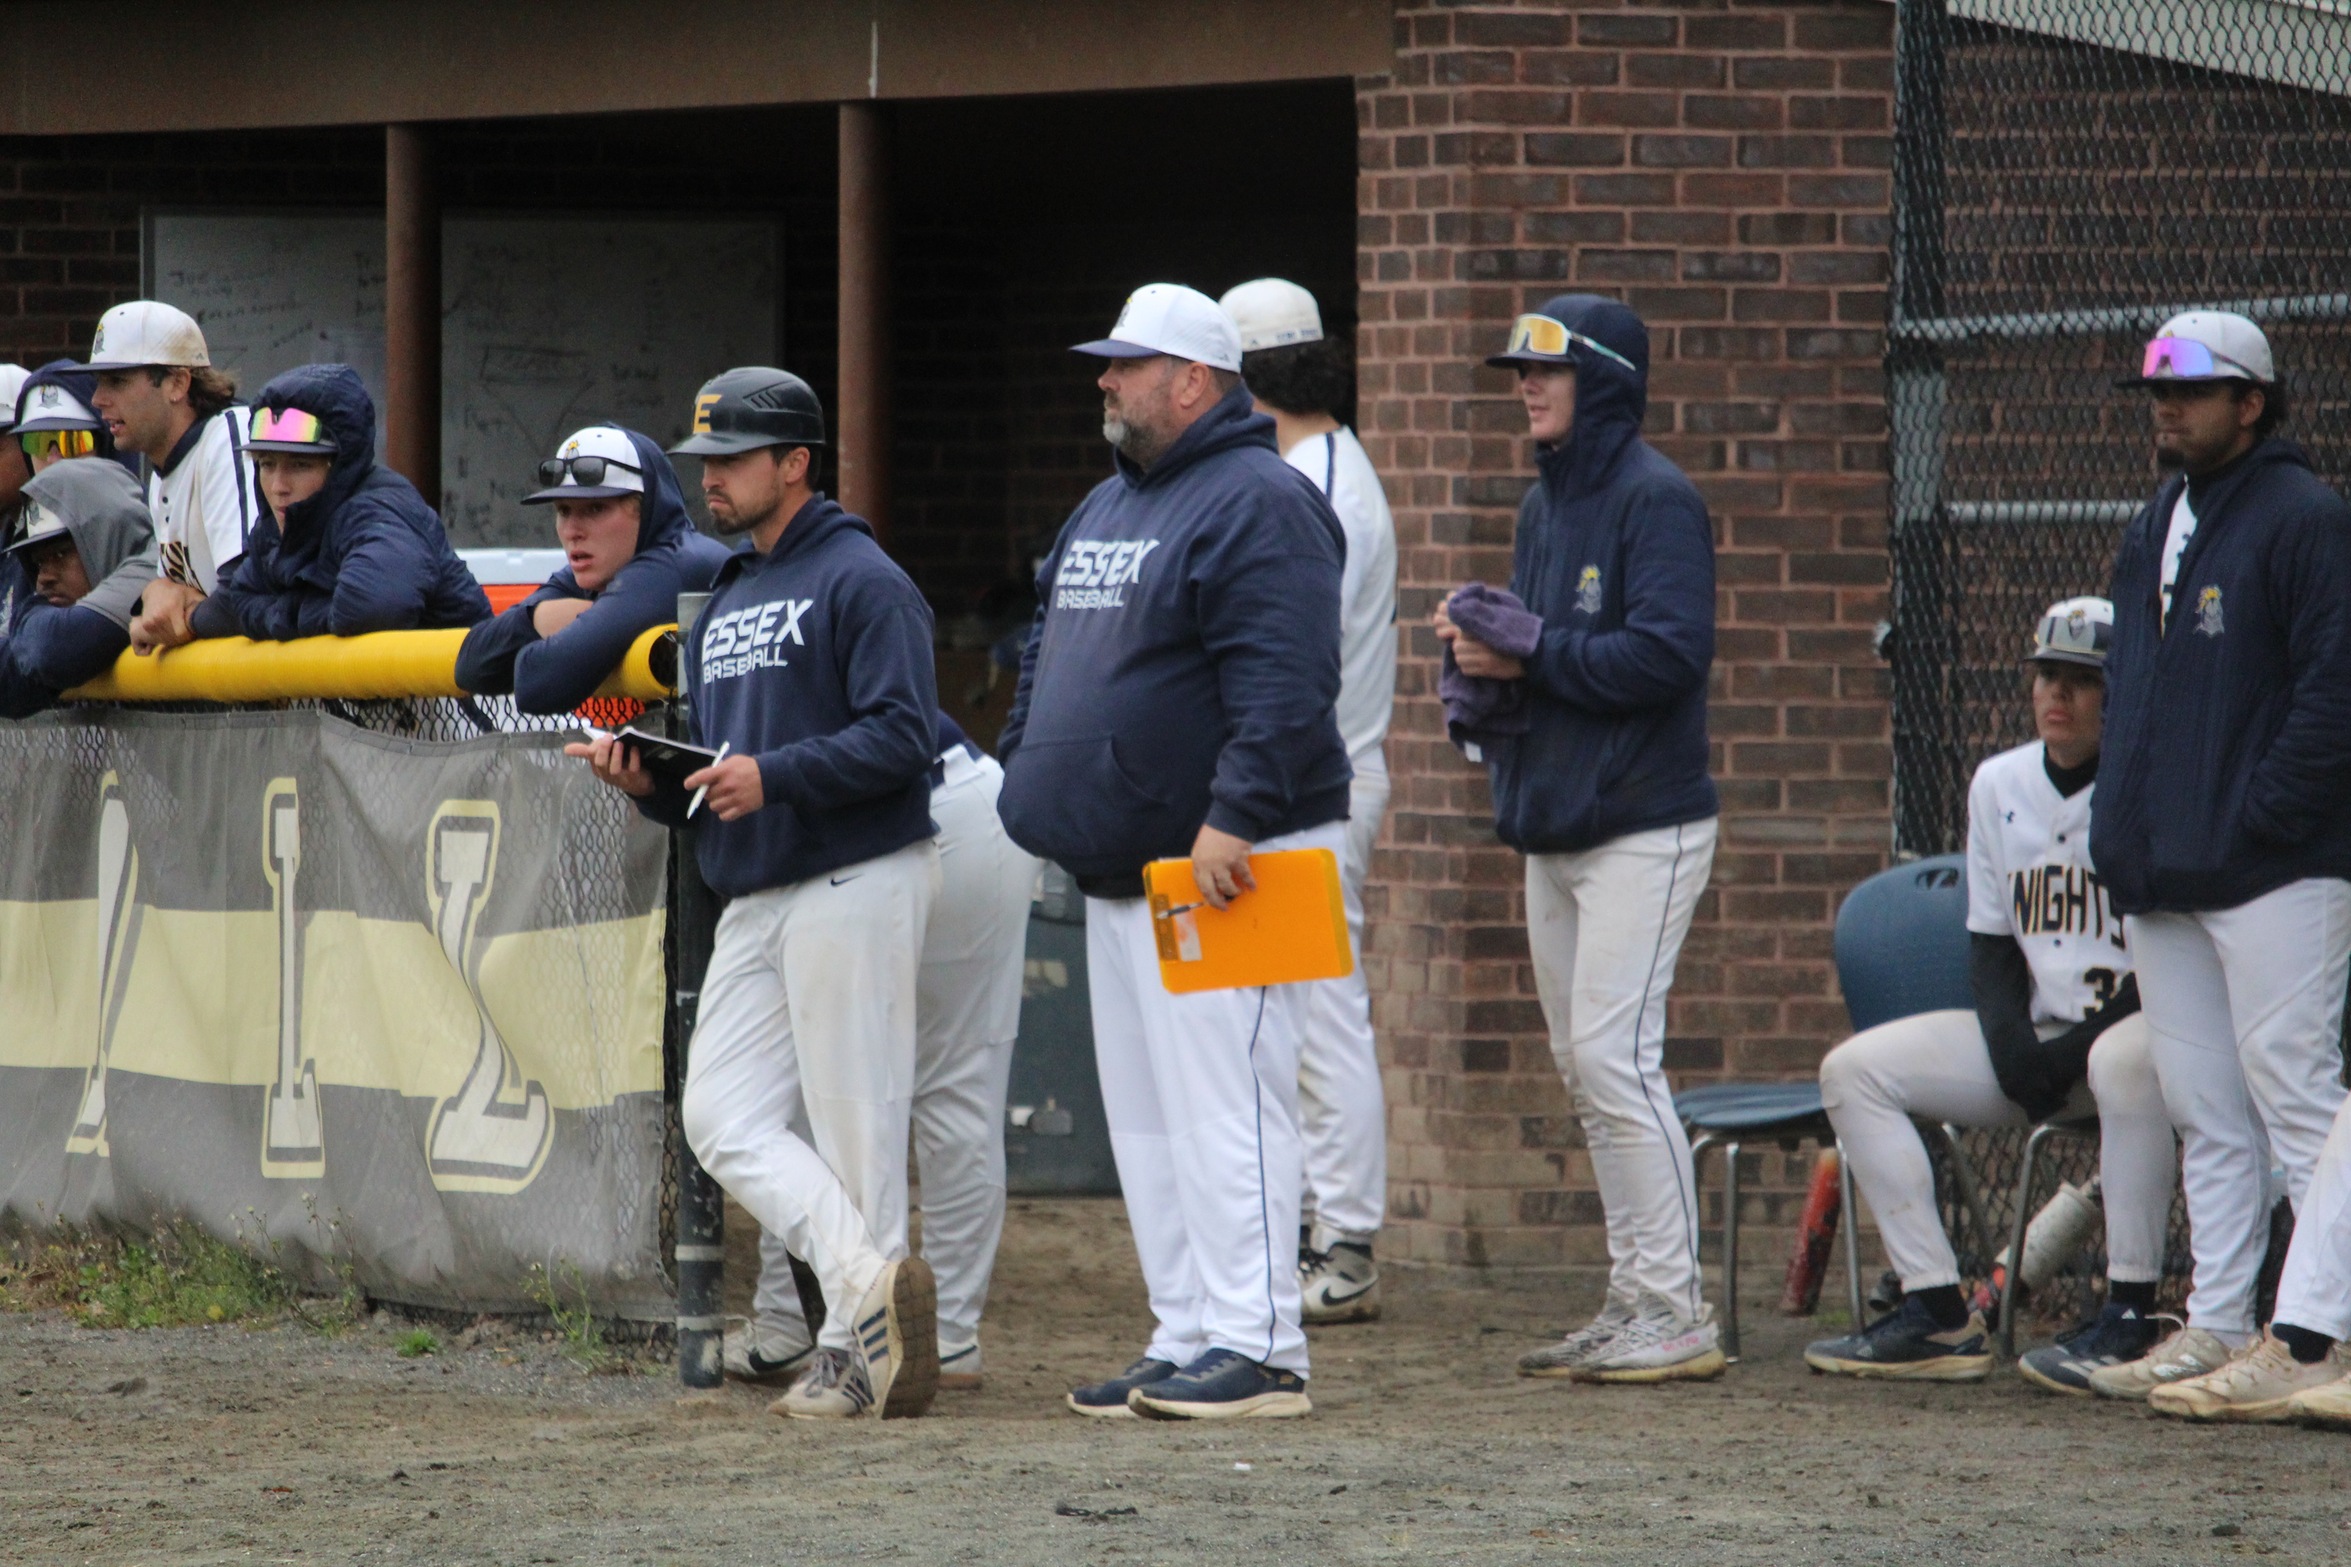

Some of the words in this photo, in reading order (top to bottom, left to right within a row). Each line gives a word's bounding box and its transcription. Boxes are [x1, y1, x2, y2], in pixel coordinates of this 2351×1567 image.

[693, 393, 722, 434] E
[1056, 539, 1160, 587] ESSEX
[1057, 585, 1125, 611] BASEBALL
[702, 599, 814, 665] ESSEX
[702, 644, 788, 685] BASEBALL
[2007, 864, 2127, 952] NIGHTS
